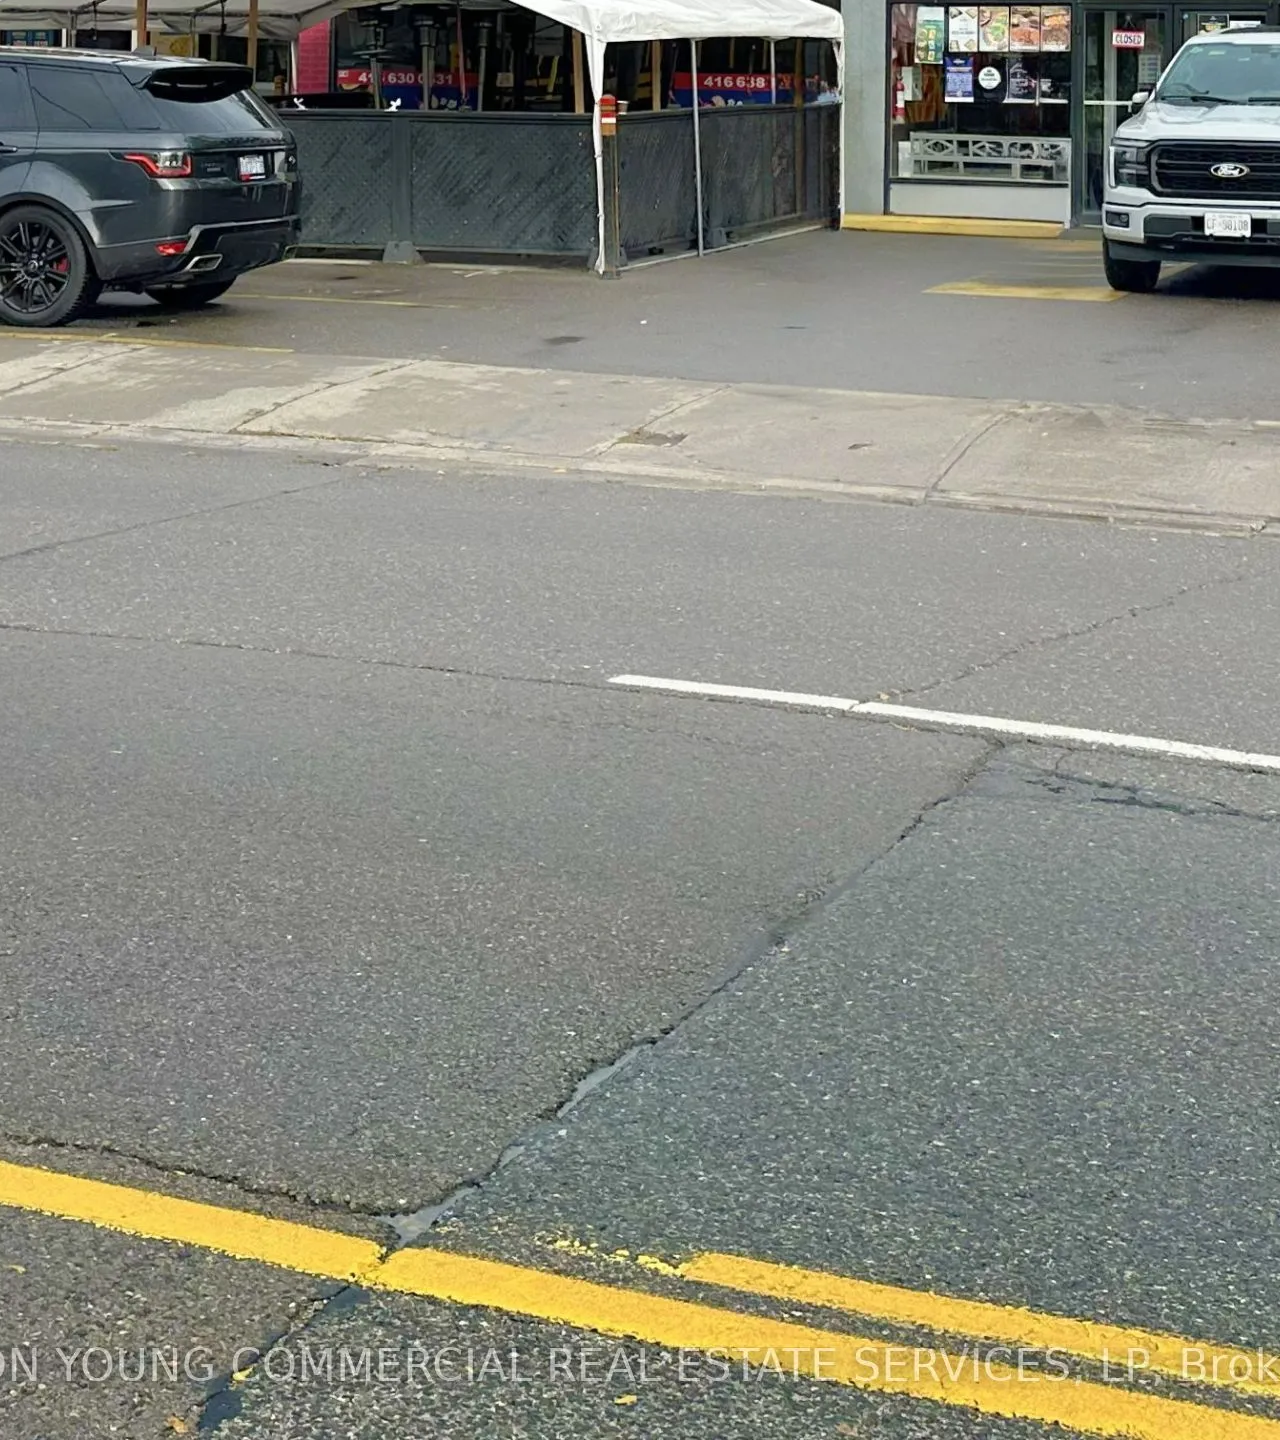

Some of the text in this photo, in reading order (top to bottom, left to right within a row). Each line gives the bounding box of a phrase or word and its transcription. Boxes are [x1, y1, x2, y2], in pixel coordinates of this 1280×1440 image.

[1115, 33, 1142, 44] CLOSED
[388, 72, 415, 84] 630
[704, 76, 733, 88] 416
